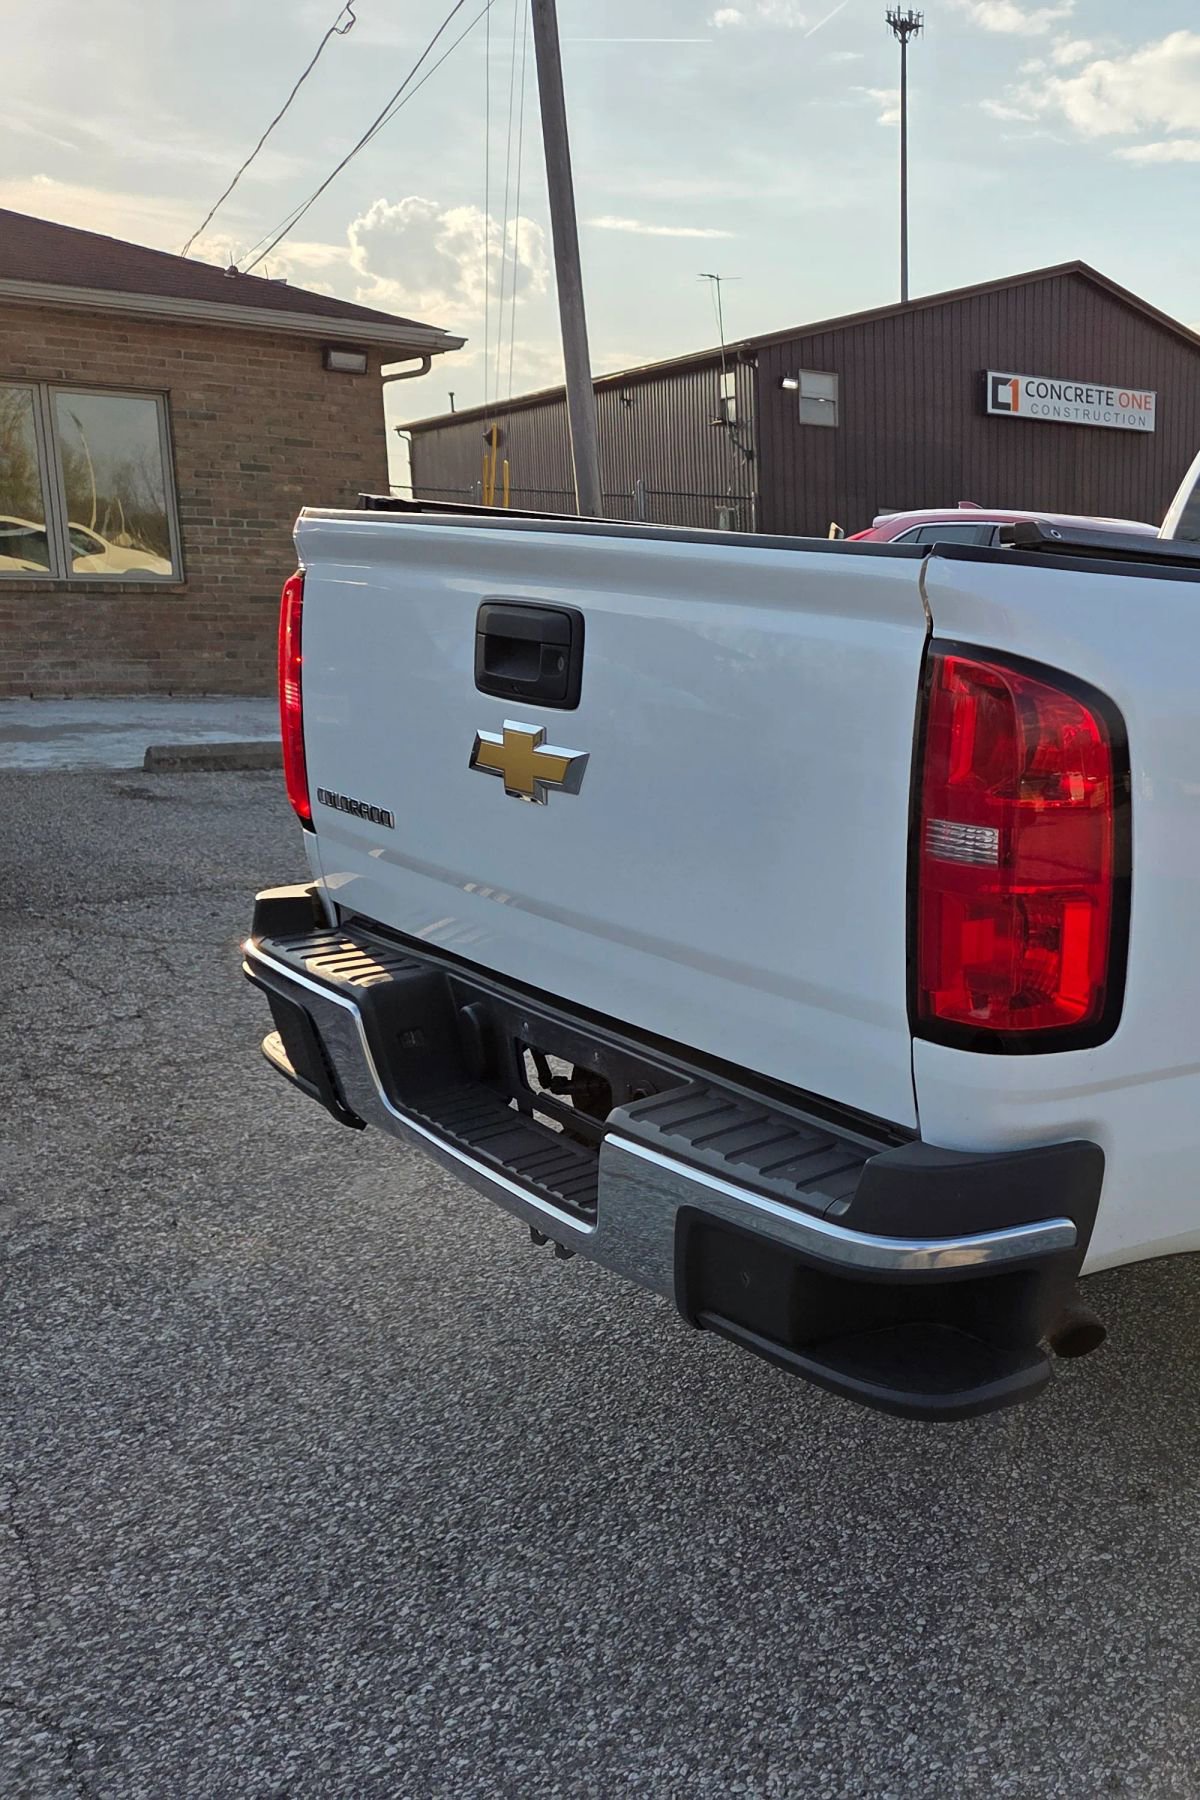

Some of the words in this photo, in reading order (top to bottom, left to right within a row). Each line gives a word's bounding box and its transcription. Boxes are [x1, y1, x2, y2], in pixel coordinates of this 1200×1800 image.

[1025, 381, 1114, 406] CONCRETE
[1118, 392, 1152, 411] ONE
[1030, 403, 1146, 426] CONSTRUCTION
